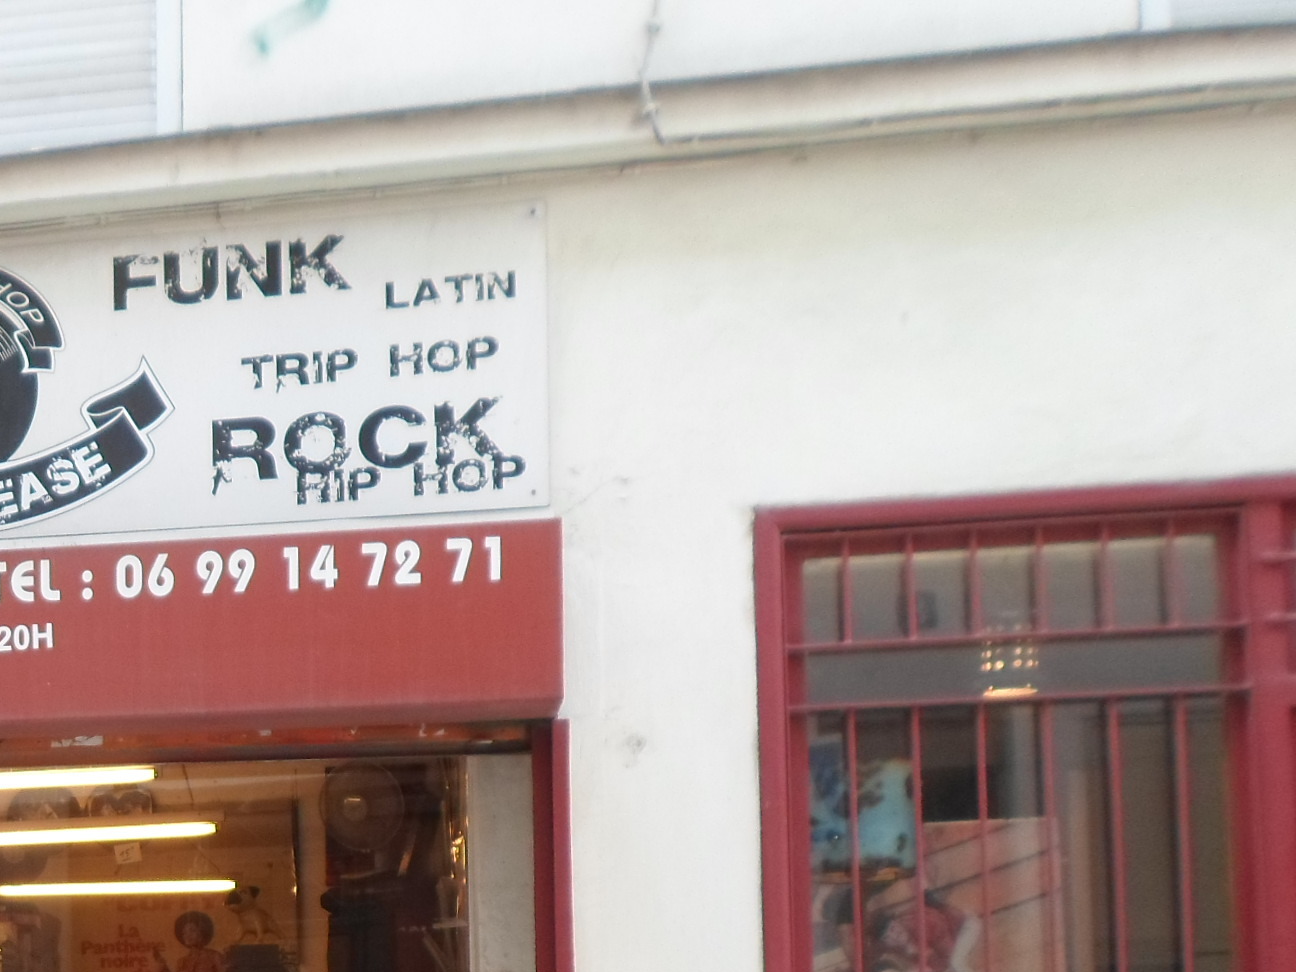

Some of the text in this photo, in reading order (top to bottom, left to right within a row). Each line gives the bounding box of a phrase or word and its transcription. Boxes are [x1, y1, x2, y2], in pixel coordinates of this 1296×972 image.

[111, 234, 352, 311] FUNK
[385, 270, 517, 309] LATIN
[241, 336, 499, 393] TRIP HOP
[211, 396, 504, 495] ROCK
[412, 454, 527, 497] HOP
[115, 553, 175, 600] 06
[196, 548, 255, 595] 99
[283, 544, 338, 590] 14
[361, 540, 422, 586] 72
[445, 536, 503, 582] 71
[118, 925, 140, 938] La
[101, 954, 149, 968] noire
